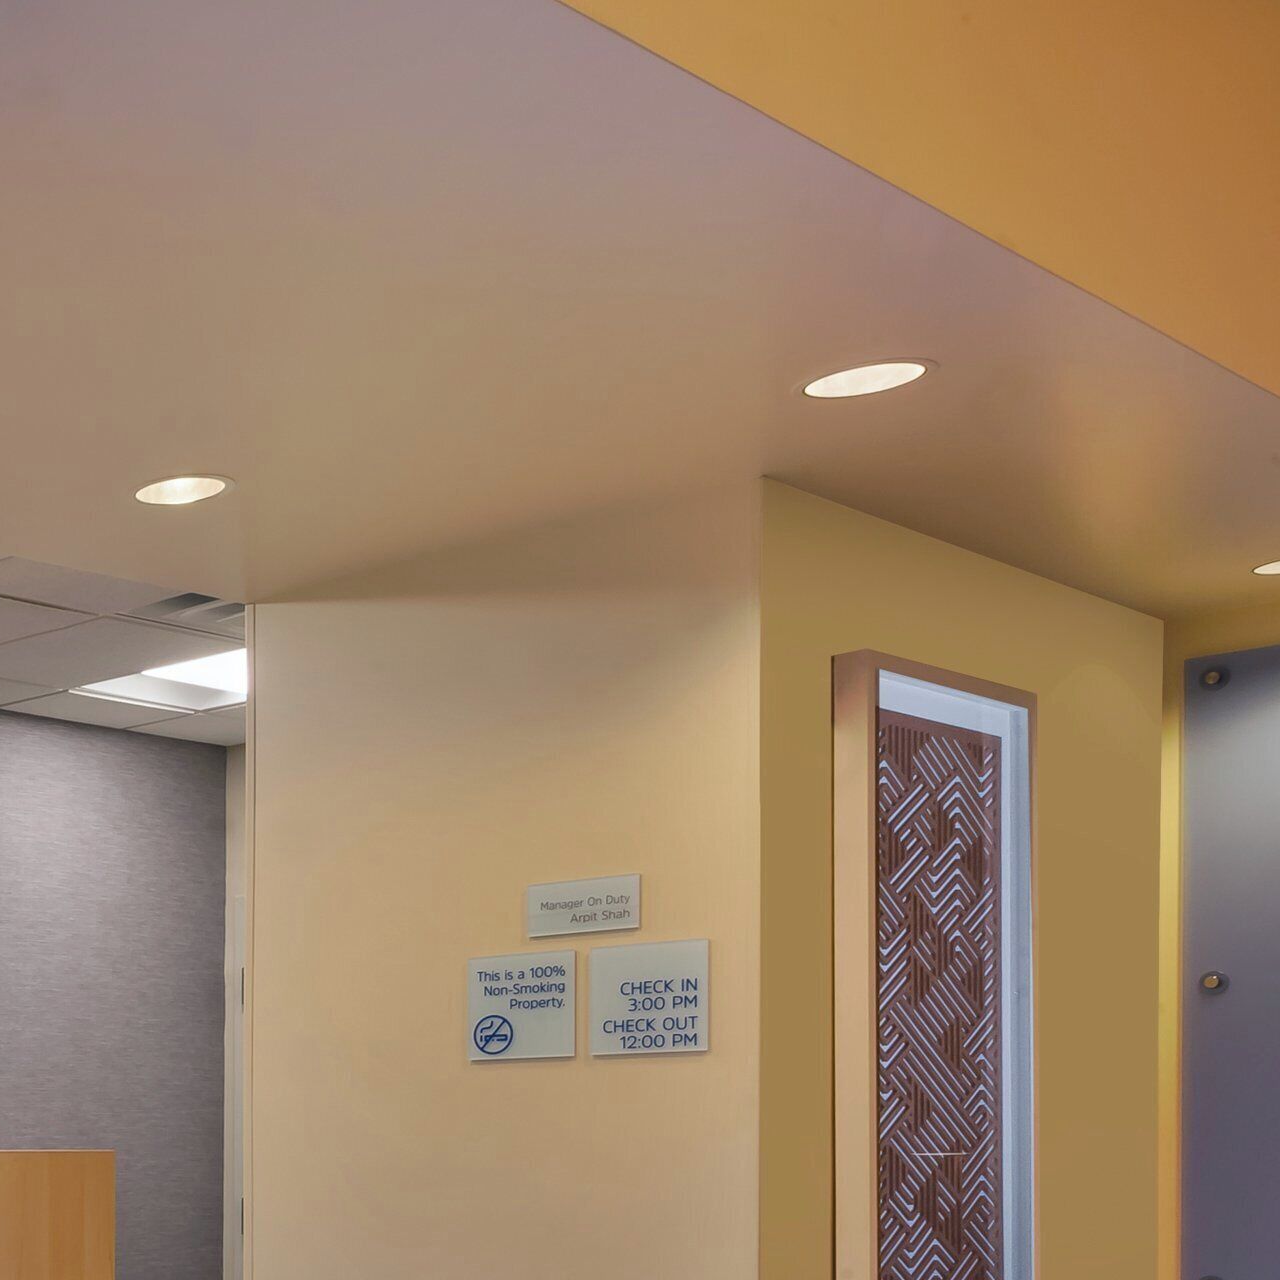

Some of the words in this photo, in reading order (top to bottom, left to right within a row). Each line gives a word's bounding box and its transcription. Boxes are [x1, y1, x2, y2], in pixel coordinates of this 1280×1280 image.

[540, 899, 585, 911] Manager
[587, 896, 602, 907] On
[605, 894, 631, 905] Duty
[570, 912, 598, 924] Arpit
[601, 908, 631, 921] Shah
[476, 971, 501, 982] This
[504, 969, 514, 981] is
[517, 970, 525, 980] a
[529, 965, 566, 979] 100%
[483, 981, 565, 997] Non-Smoking
[620, 979, 674, 996] CHECK
[681, 977, 698, 992] IN
[509, 997, 566, 1010] Property.
[627, 996, 666, 1012] 3:00
[672, 994, 698, 1010] PM
[602, 1018, 656, 1034] CHECK
[662, 1015, 698, 1031] OUT
[619, 1034, 666, 1049] 12:00
[672, 1032, 698, 1047] PM
